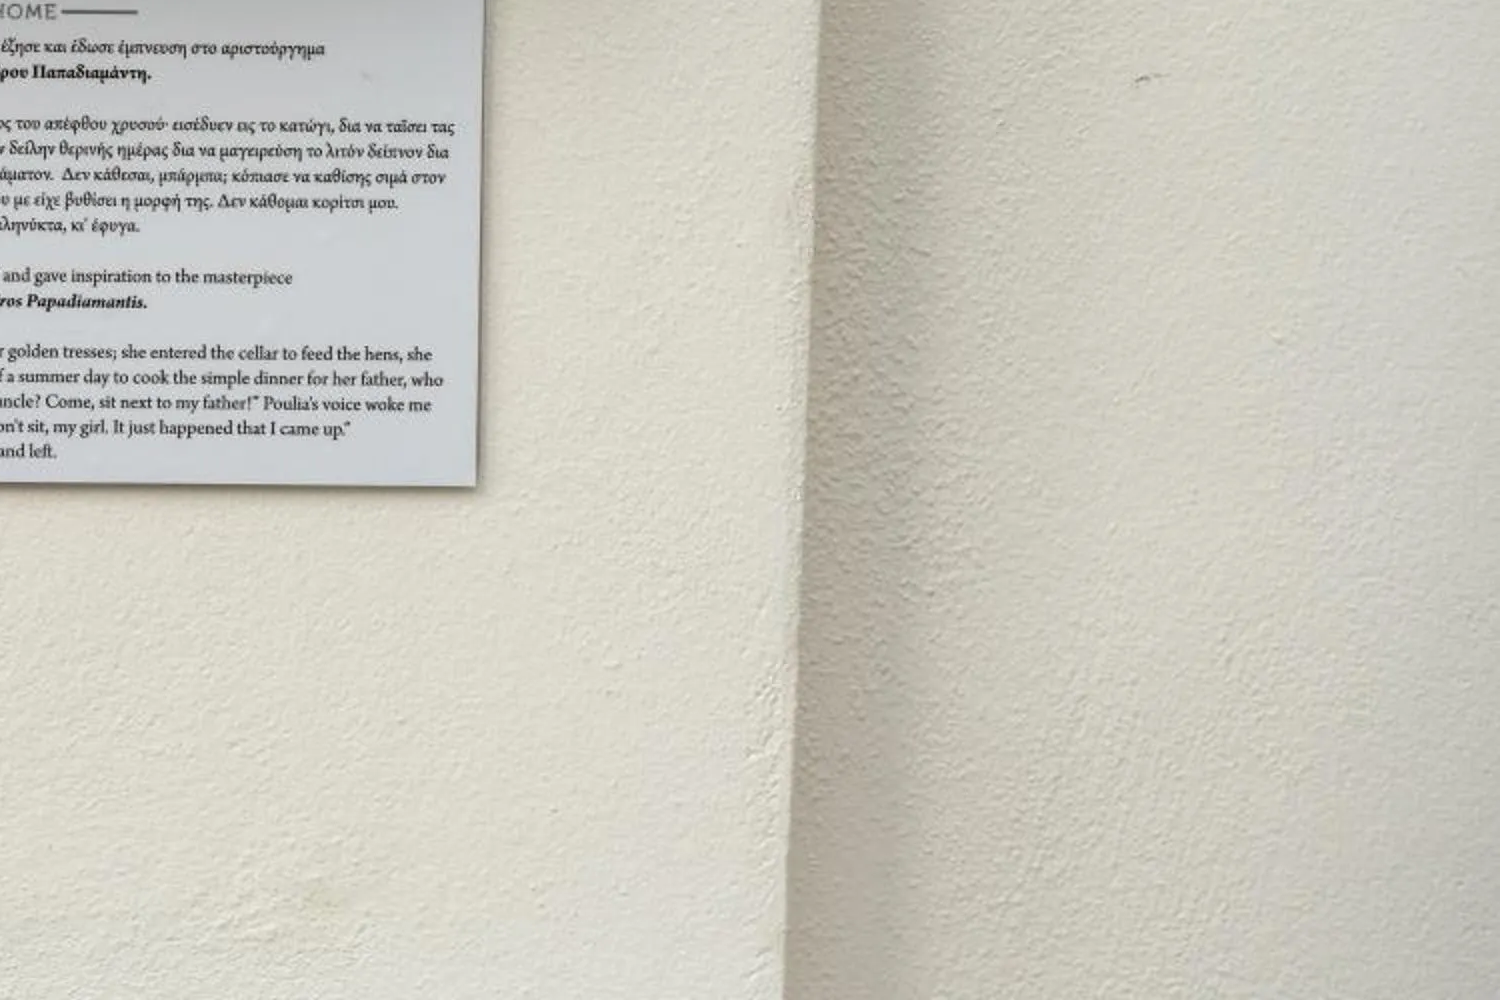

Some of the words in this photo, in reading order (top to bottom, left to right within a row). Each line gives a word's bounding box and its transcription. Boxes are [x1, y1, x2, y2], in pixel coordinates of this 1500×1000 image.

[43, 42, 68, 54] και
[69, 36, 116, 55] έδωσε
[116, 39, 188, 61] έμπνευση
[190, 42, 218, 56] στο
[220, 40, 326, 62] αριστούργημα
[30, 63, 153, 86] Παπαδιαμάντη.
[14, 118, 42, 131] του
[43, 114, 109, 136] απέφθου
[171, 114, 234, 133] εισέδυεν
[236, 120, 257, 137] εις
[257, 121, 278, 133] το
[278, 118, 336, 137] κατώγι,
[337, 116, 363, 134] δια
[363, 122, 384, 136] να
[429, 122, 456, 138] τας
[90, 217, 141, 238] έφυγα.
[1, 265, 32, 284] and
[32, 271, 68, 289] gave
[70, 268, 153, 289] inspiration
[155, 270, 173, 284] to
[174, 267, 200, 284] the
[202, 270, 293, 290] masterpiece
[25, 292, 148, 313] Papadiamantis.
[6, 342, 60, 364] golden
[62, 345, 118, 362] tresses;
[120, 343, 148, 360] she
[149, 343, 208, 361] entered
[209, 343, 235, 361] the
[237, 343, 280, 361] cellar
[281, 347, 299, 361] to
[300, 344, 334, 362] feed
[336, 344, 361, 362] the
[363, 345, 404, 365] hens,
[406, 345, 434, 363] she
[44, 393, 96, 413] Come,
[97, 395, 117, 410] sit
[119, 395, 154, 410] next
[155, 396, 173, 410] to
[174, 398, 202, 415] my
[321, 396, 362, 412] voice
[364, 395, 406, 413] woke
[407, 400, 433, 413] me
[26, 418, 50, 437] sit,
[52, 423, 78, 439] my
[78, 418, 109, 440] girl.
[112, 418, 126, 435] It
[127, 419, 157, 439] just
[158, 418, 234, 440] happened
[236, 418, 267, 436] that
[269, 420, 277, 437] I
[278, 424, 322, 437] came
[28, 442, 58, 460] left.
